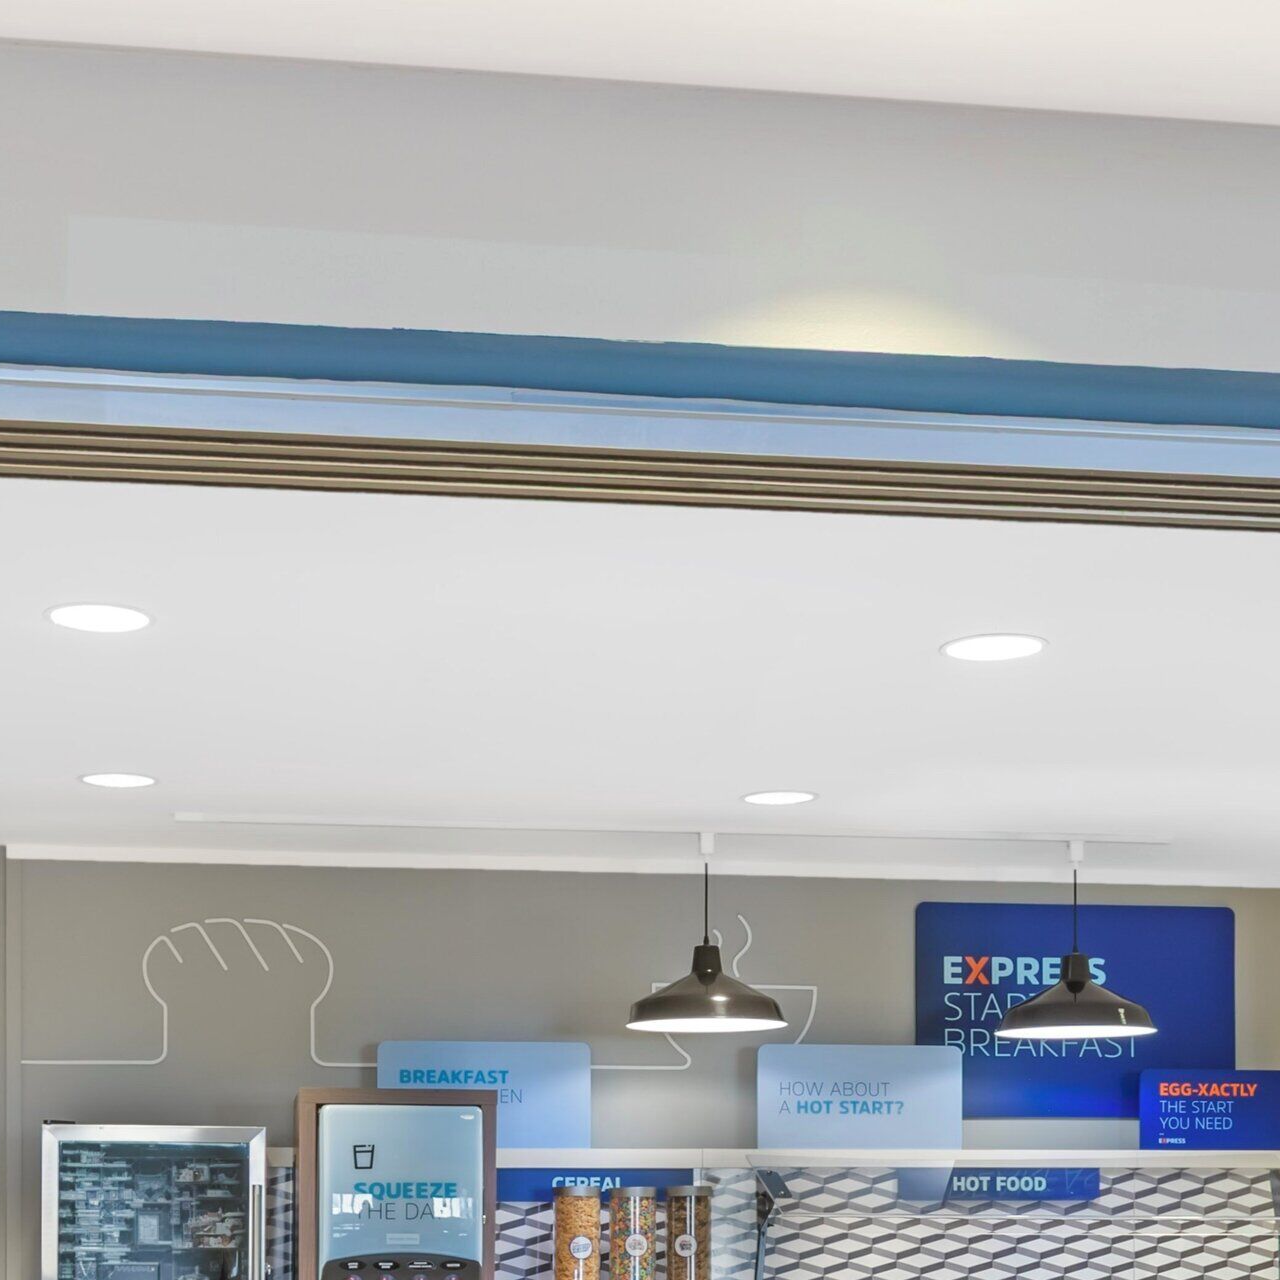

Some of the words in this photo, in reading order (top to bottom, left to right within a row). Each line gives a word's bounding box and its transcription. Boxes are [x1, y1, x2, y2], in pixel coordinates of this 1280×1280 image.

[943, 955, 1107, 985] EXPRES
[399, 1069, 509, 1084] BREAKFAST
[779, 1081, 824, 1097] HOW
[830, 1081, 891, 1097] ABOUT
[1159, 1082, 1258, 1097] EGG-XACTLY
[778, 1100, 791, 1114] A
[796, 1100, 833, 1115] HOT
[839, 1100, 905, 1115] START?
[1160, 1100, 1187, 1114] THE
[1191, 1100, 1234, 1114] START
[1160, 1117, 1190, 1130] YOU
[1195, 1117, 1233, 1130] NEED
[353, 1182, 458, 1199] SQUEEZE
[952, 1176, 991, 1192] HOT
[996, 1176, 1047, 1192] FOOD
[405, 1202, 442, 1220] DA
